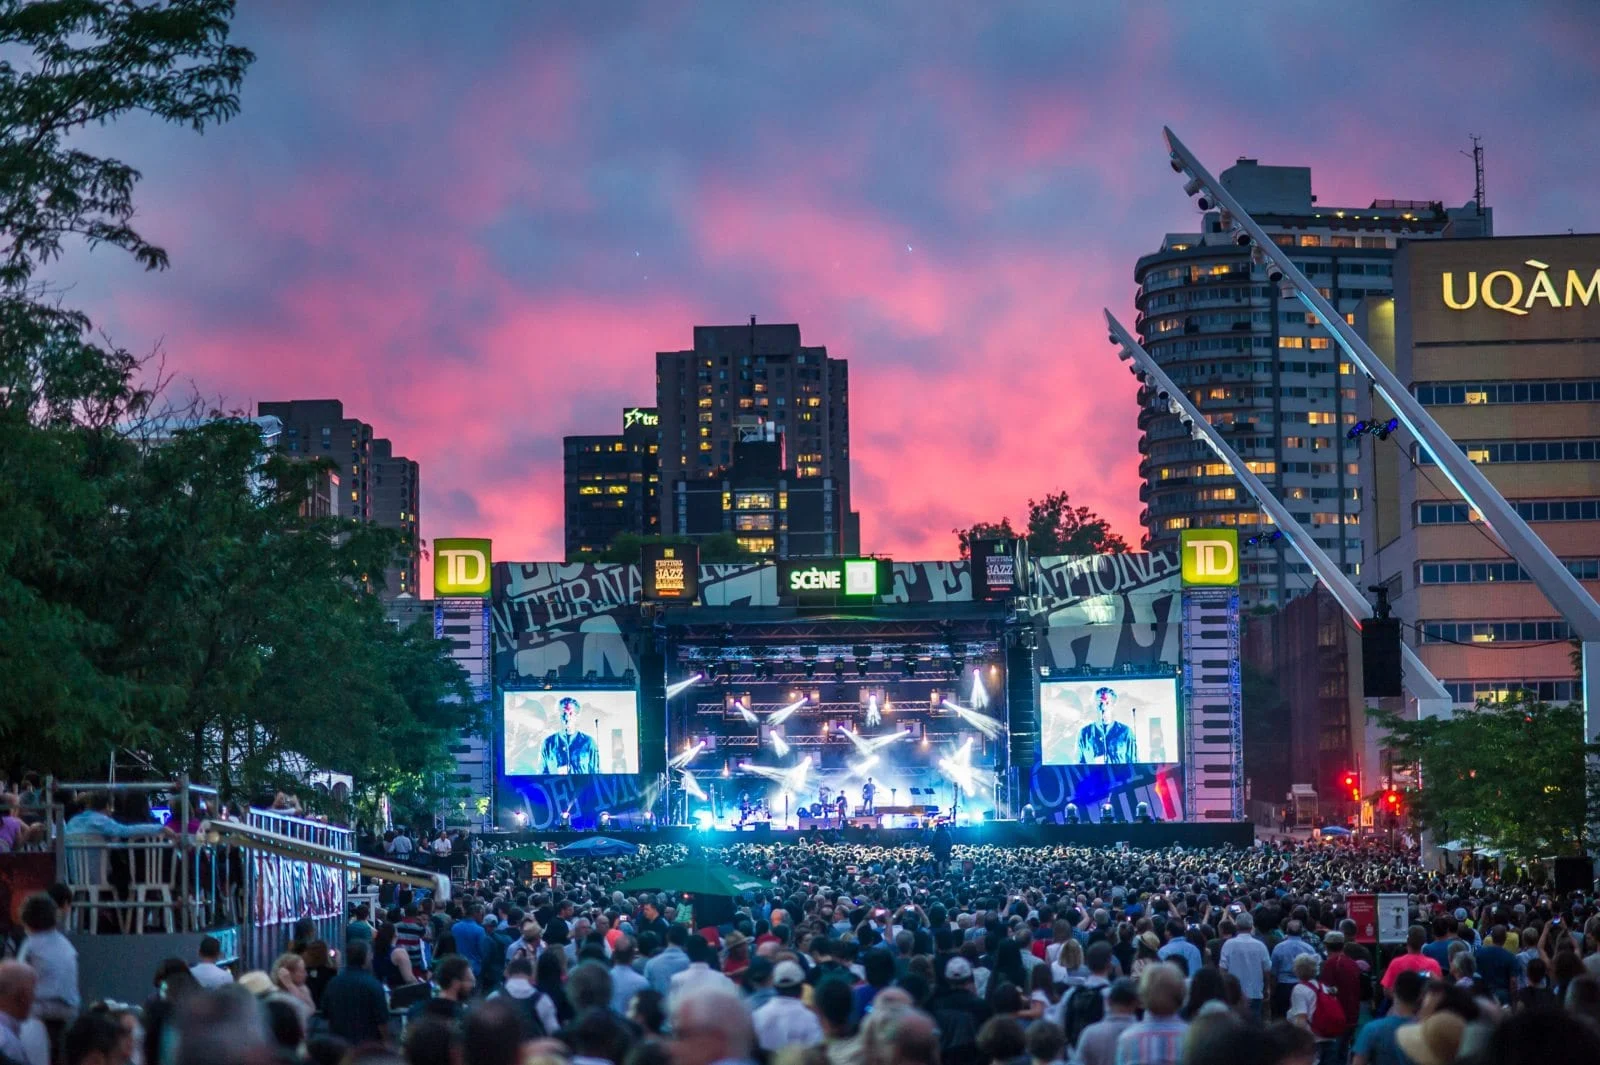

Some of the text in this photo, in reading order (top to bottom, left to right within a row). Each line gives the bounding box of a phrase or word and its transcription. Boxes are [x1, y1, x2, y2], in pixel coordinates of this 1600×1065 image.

[1443, 259, 1600, 315] UQÀM
[438, 549, 486, 585] TD
[986, 565, 1014, 576] JAZZ
[1186, 540, 1234, 575] TD
[655, 569, 684, 580] JAZZ
[790, 567, 841, 589] SCÈNE
